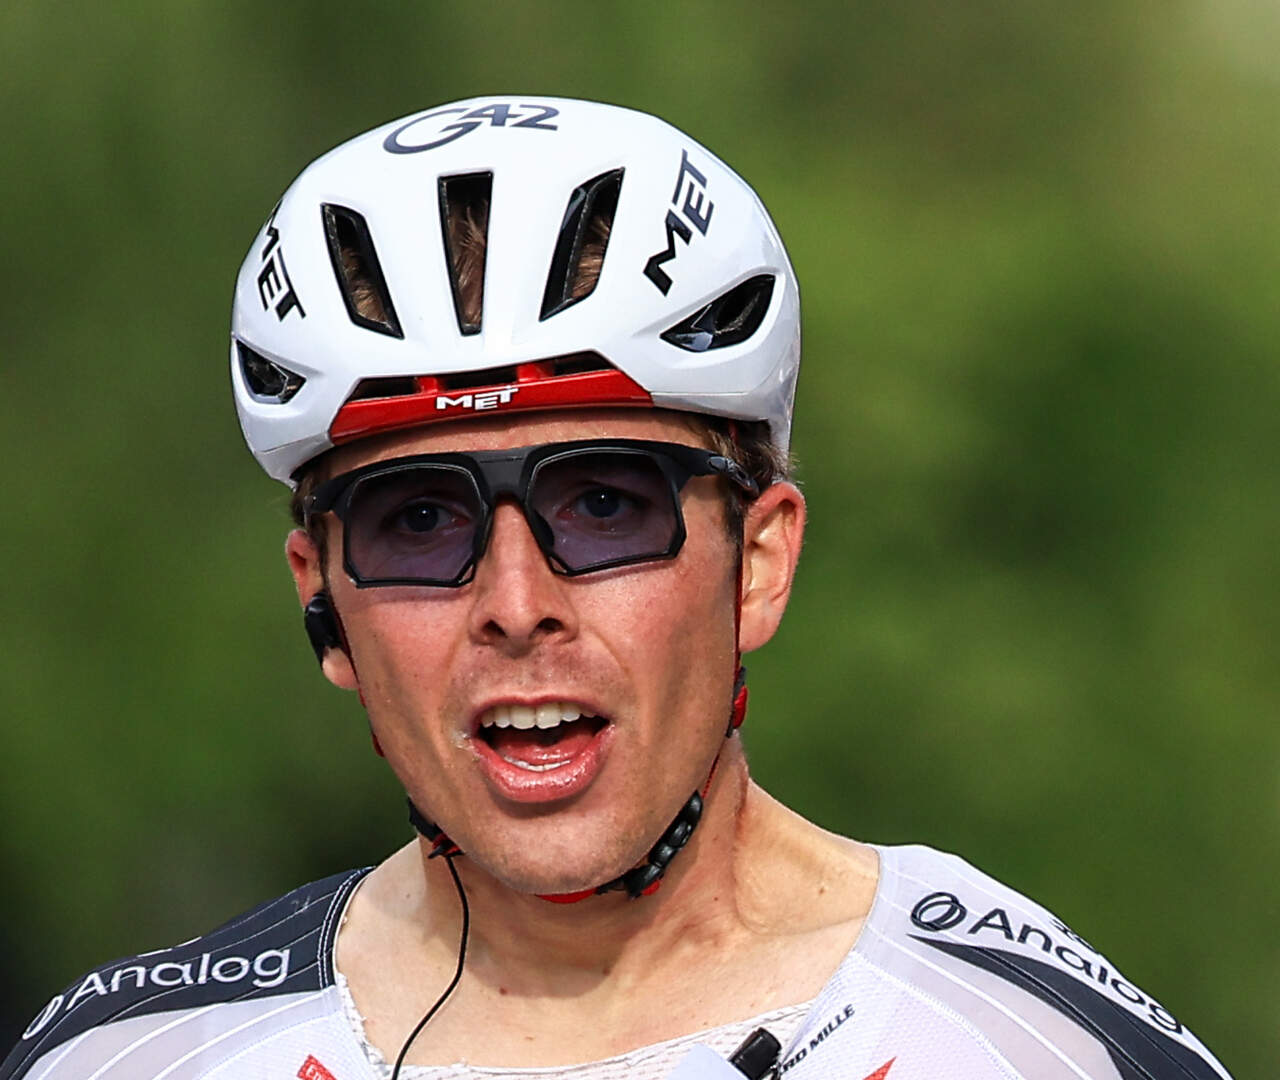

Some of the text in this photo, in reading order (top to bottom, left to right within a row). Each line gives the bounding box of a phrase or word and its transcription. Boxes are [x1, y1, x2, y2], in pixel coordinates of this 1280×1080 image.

[383, 104, 558, 155] G42
[643, 149, 715, 296] MET
[436, 384, 518, 411] MET
[65, 949, 290, 1011] Analog
[968, 908, 1183, 1034] Analog
[809, 1004, 855, 1050] MILLE
